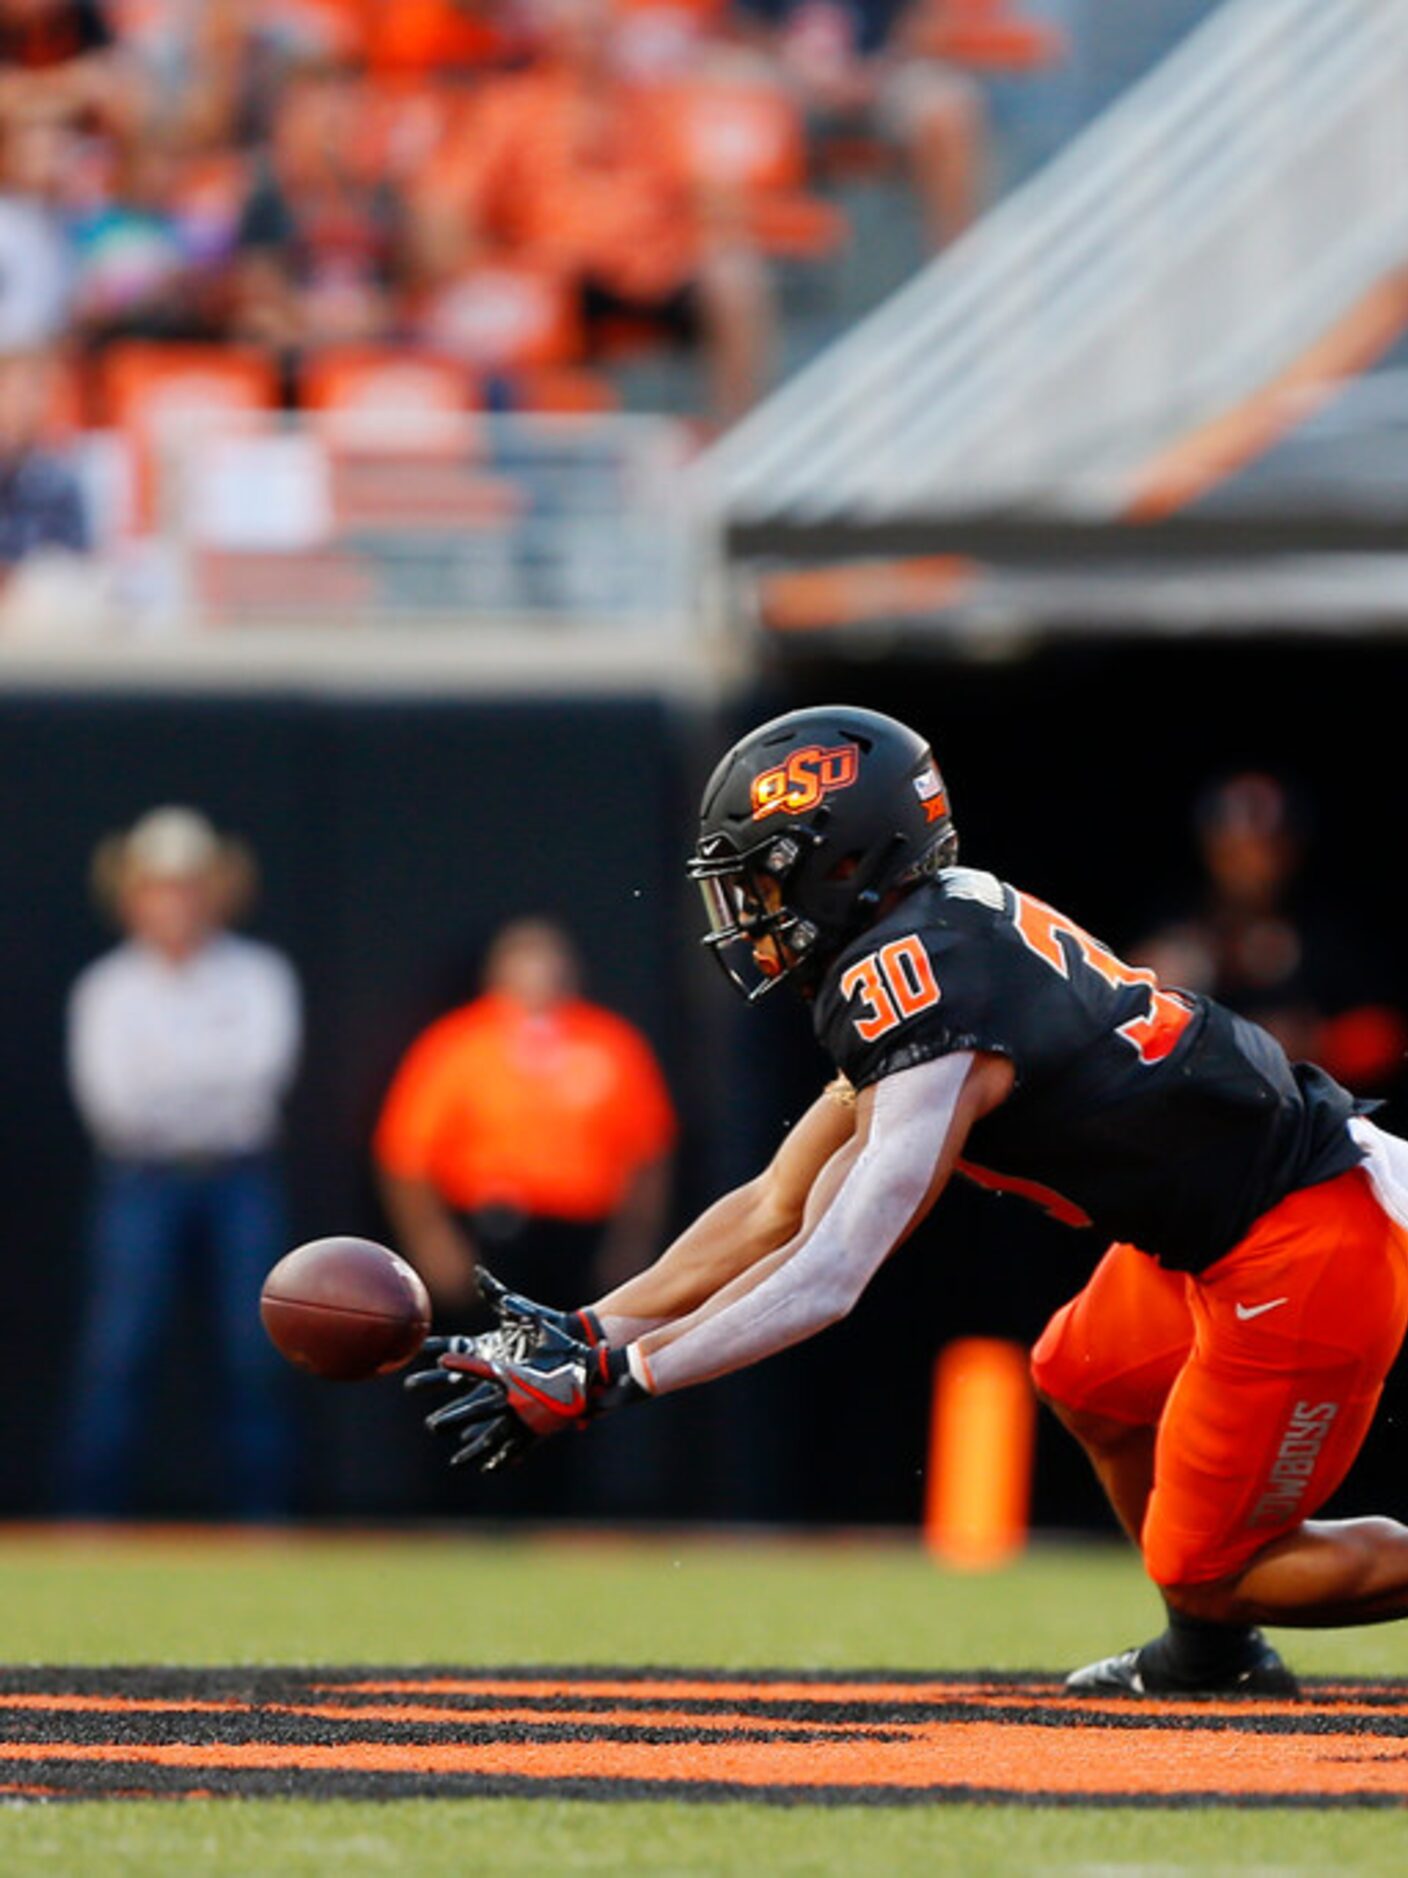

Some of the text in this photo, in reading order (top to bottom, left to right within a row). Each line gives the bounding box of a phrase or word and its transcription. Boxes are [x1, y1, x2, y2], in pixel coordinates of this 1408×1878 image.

[750, 743, 859, 821] OSU
[841, 934, 941, 1042] 30
[1249, 1400, 1339, 1529] COWBOYS
